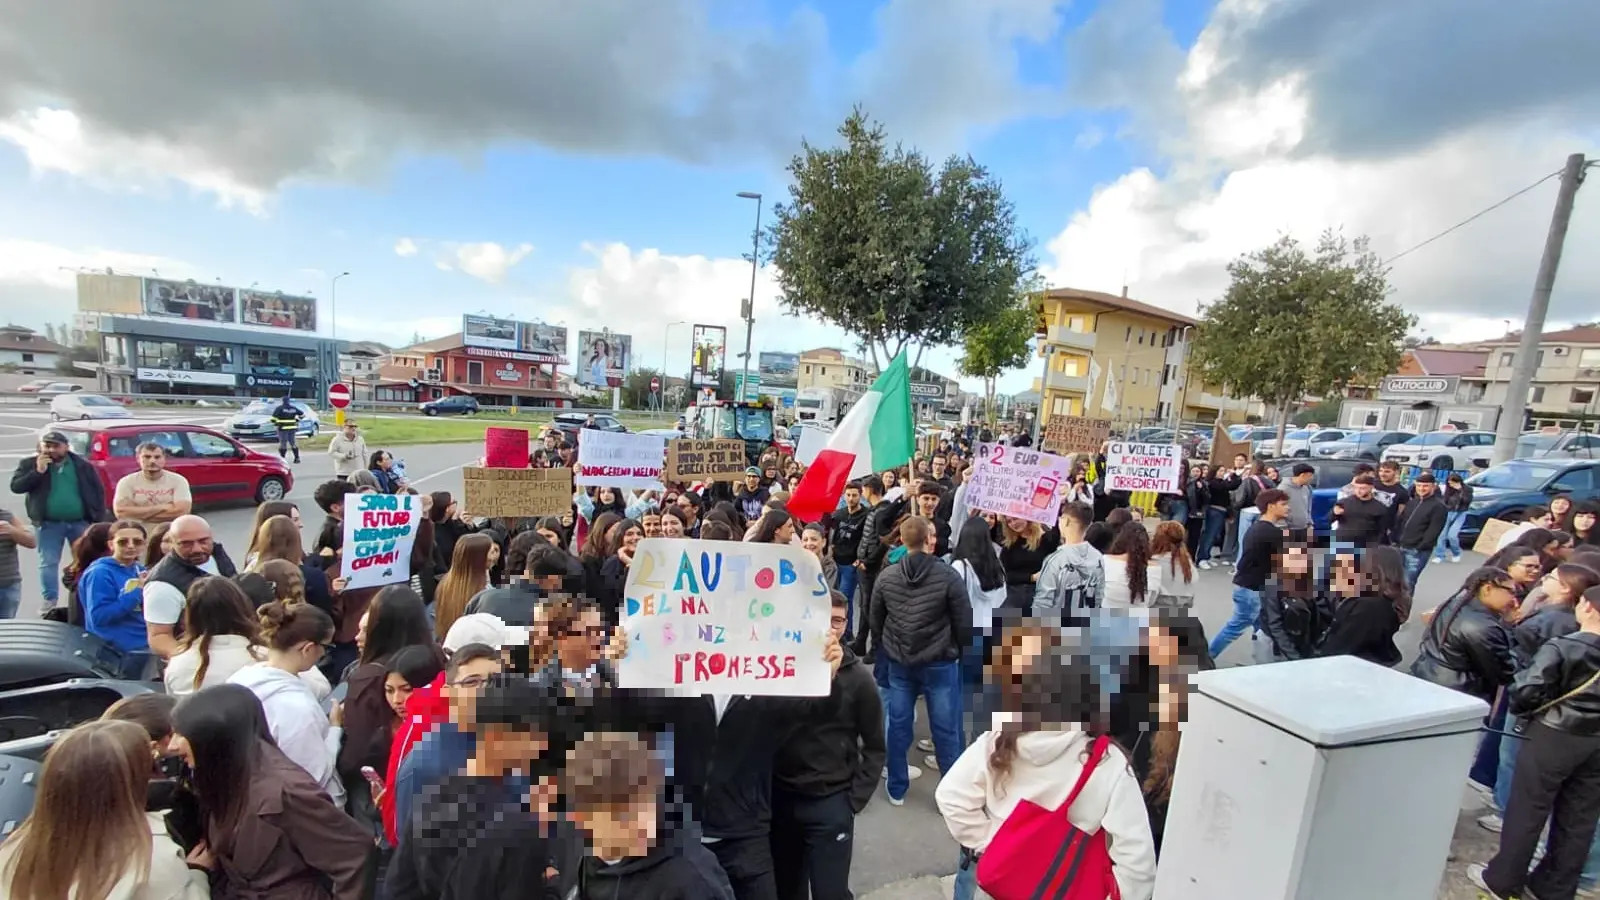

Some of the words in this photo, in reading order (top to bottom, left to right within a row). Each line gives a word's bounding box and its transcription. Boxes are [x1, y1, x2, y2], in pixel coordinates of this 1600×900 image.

[257, 378, 295, 386] RENAULT
[1392, 381, 1442, 390] AUTOCLUB
[910, 386, 938, 394] TOCLUB
[695, 440, 714, 451] QUA
[715, 442, 731, 451] CHI
[732, 442, 741, 450] CI
[1111, 444, 1122, 454] CI
[1128, 444, 1173, 457] VOLETE
[709, 451, 725, 463] STA
[730, 451, 742, 462] IN
[980, 445, 989, 458] A
[990, 446, 1004, 465] 2
[1121, 455, 1174, 467] IGNORANTI
[469, 468, 484, 480] LA
[706, 464, 711, 473] E
[979, 463, 990, 473] AL
[992, 466, 1014, 476] LITRO
[1107, 465, 1122, 475] PER
[1126, 467, 1161, 478] AVERCI
[465, 480, 485, 489] NON
[496, 482, 509, 491] SI
[519, 481, 566, 493] COMPRA
[971, 475, 1011, 490] ALMENO
[1113, 475, 1171, 491] OBBEDIENTI
[496, 490, 530, 498] VIVERE
[987, 488, 1023, 501] BENZINA
[517, 506, 565, 517] TROPPO
[363, 511, 410, 528] FUTURO
[632, 549, 828, 597] L'AUTOBUS
[626, 593, 672, 616] DEL
[673, 650, 797, 685] PROMESSE
